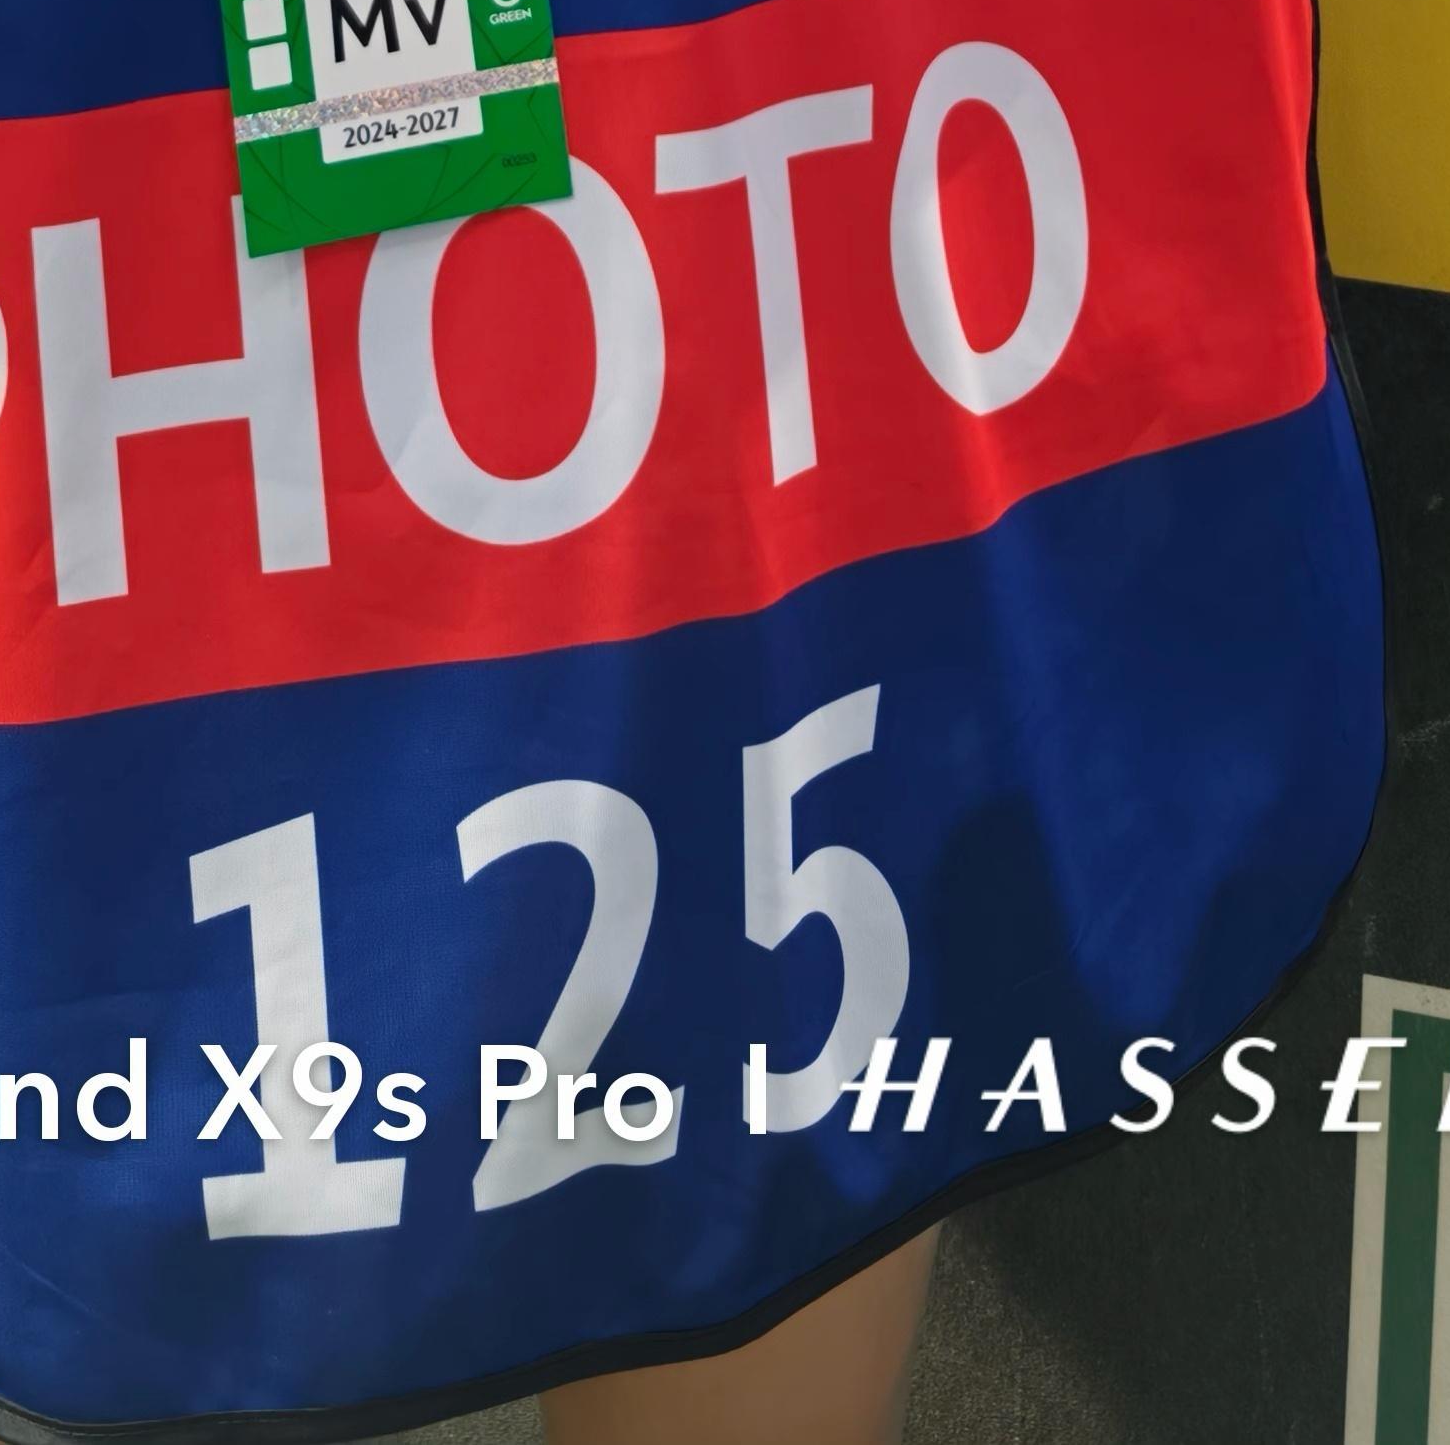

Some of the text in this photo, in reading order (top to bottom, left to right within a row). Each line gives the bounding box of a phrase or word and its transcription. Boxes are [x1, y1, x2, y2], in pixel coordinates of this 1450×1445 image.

[489, 7, 532, 25] GREEN
[342, 105, 460, 148] 2024-2027
[189, 683, 911, 1241] 125
